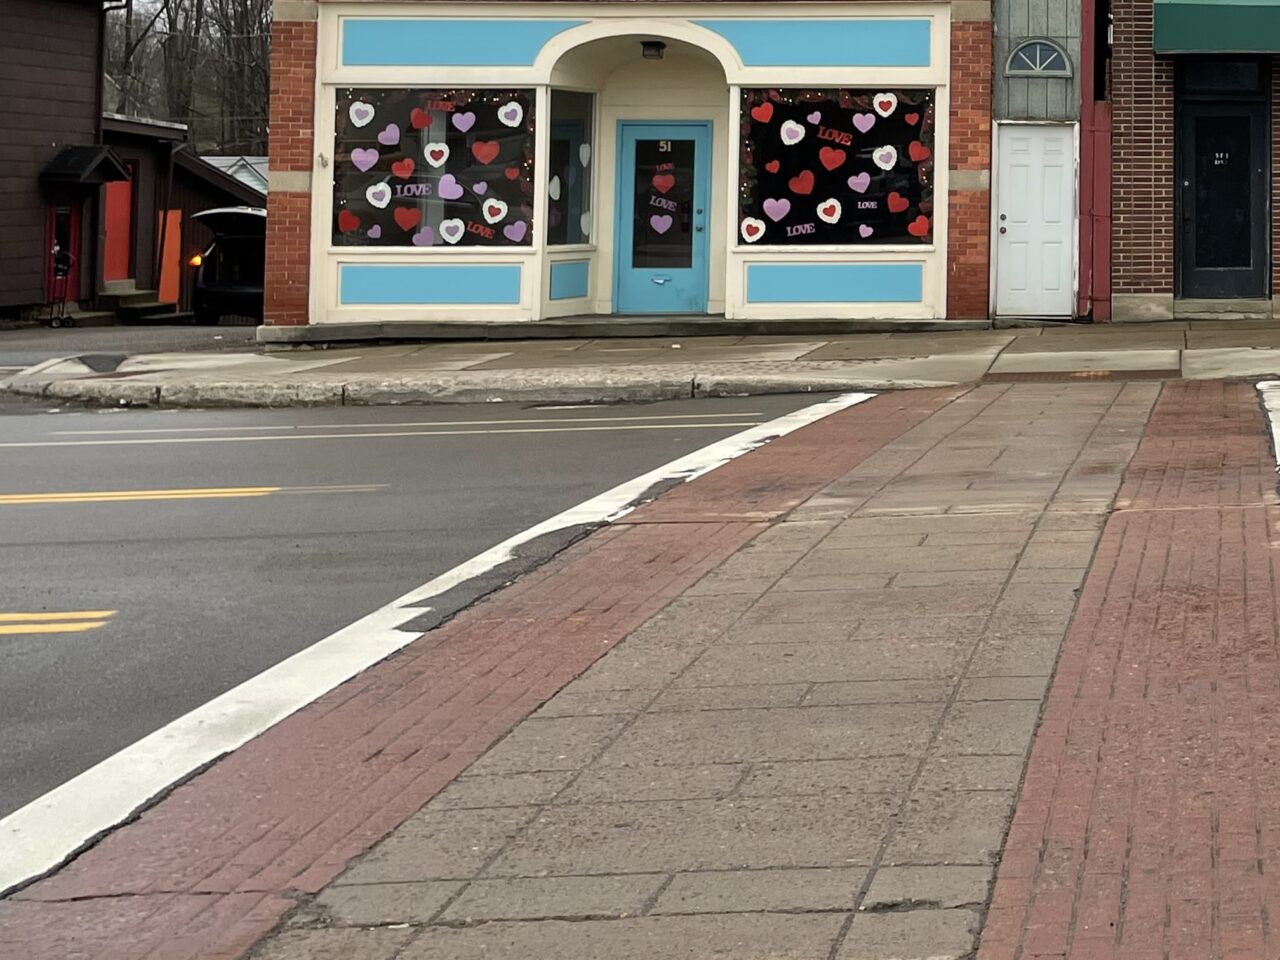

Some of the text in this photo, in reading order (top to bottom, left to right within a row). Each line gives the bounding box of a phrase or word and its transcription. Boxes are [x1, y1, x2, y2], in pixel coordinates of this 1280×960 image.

[817, 127, 853, 146] LOVE
[658, 140, 672, 152] 51
[395, 184, 432, 197] LOVE
[650, 196, 677, 211] LOVE
[466, 221, 496, 239] LOVE
[786, 224, 815, 236] LOVE
